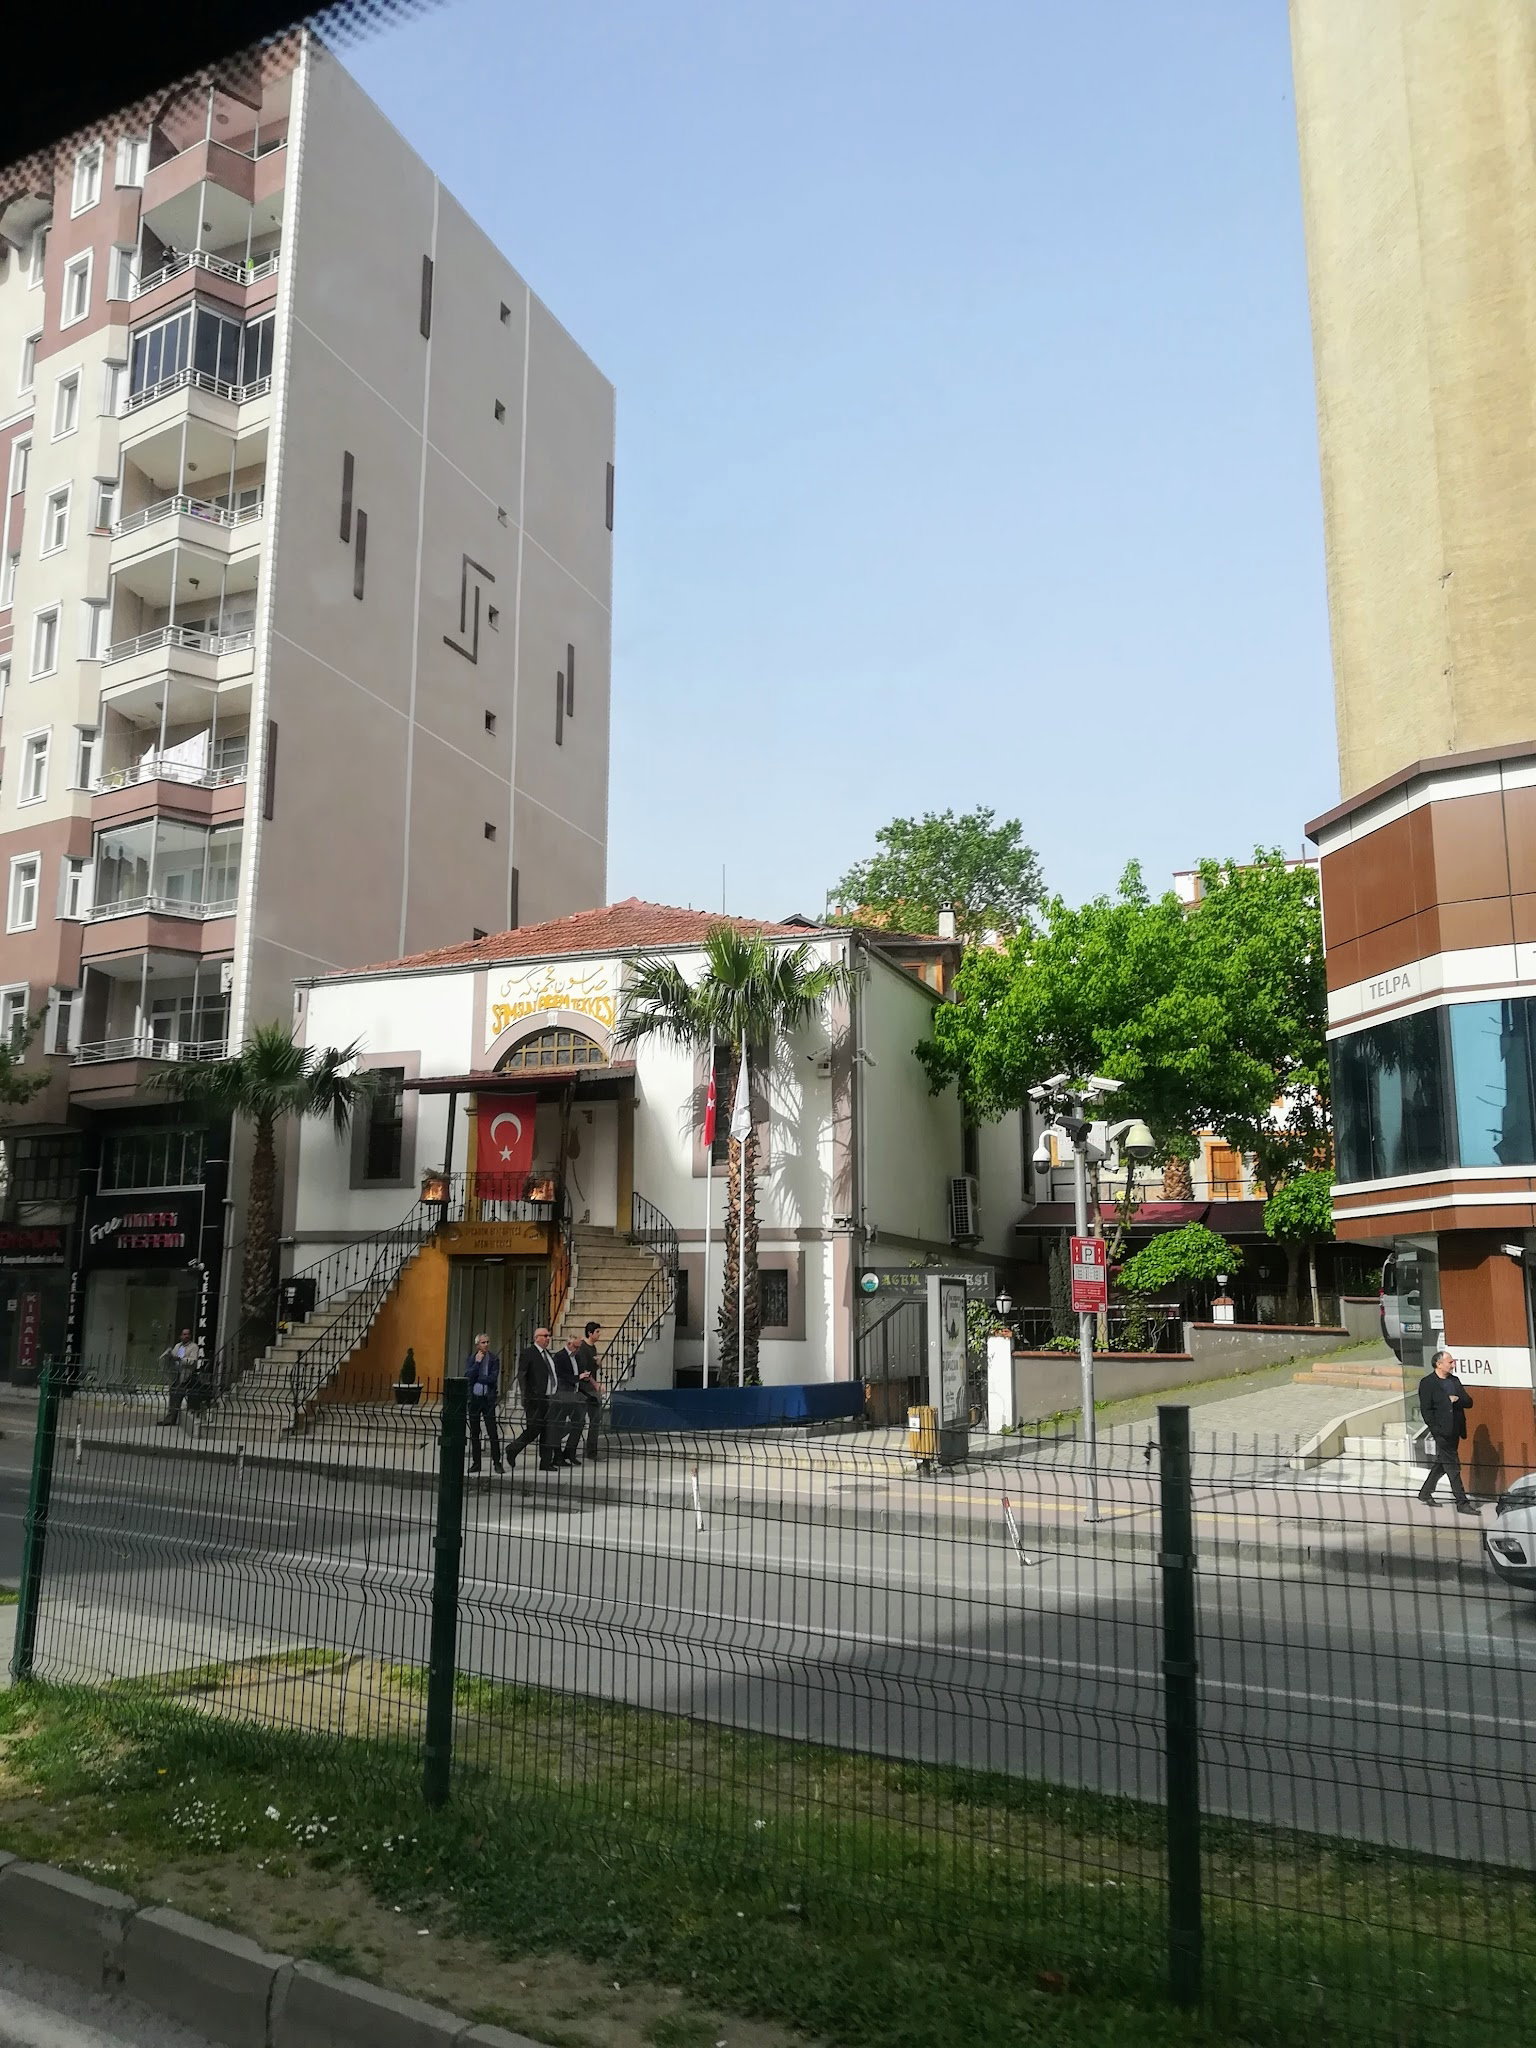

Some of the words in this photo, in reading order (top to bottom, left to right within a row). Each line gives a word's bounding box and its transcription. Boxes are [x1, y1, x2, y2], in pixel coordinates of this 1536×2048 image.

[1369, 972, 1411, 999] TELPA
[492, 1001, 537, 1035] SAMSUN
[88, 1216, 124, 1245] Free
[1084, 1248, 1093, 1261] P
[1453, 1358, 1493, 1375] TELPA
